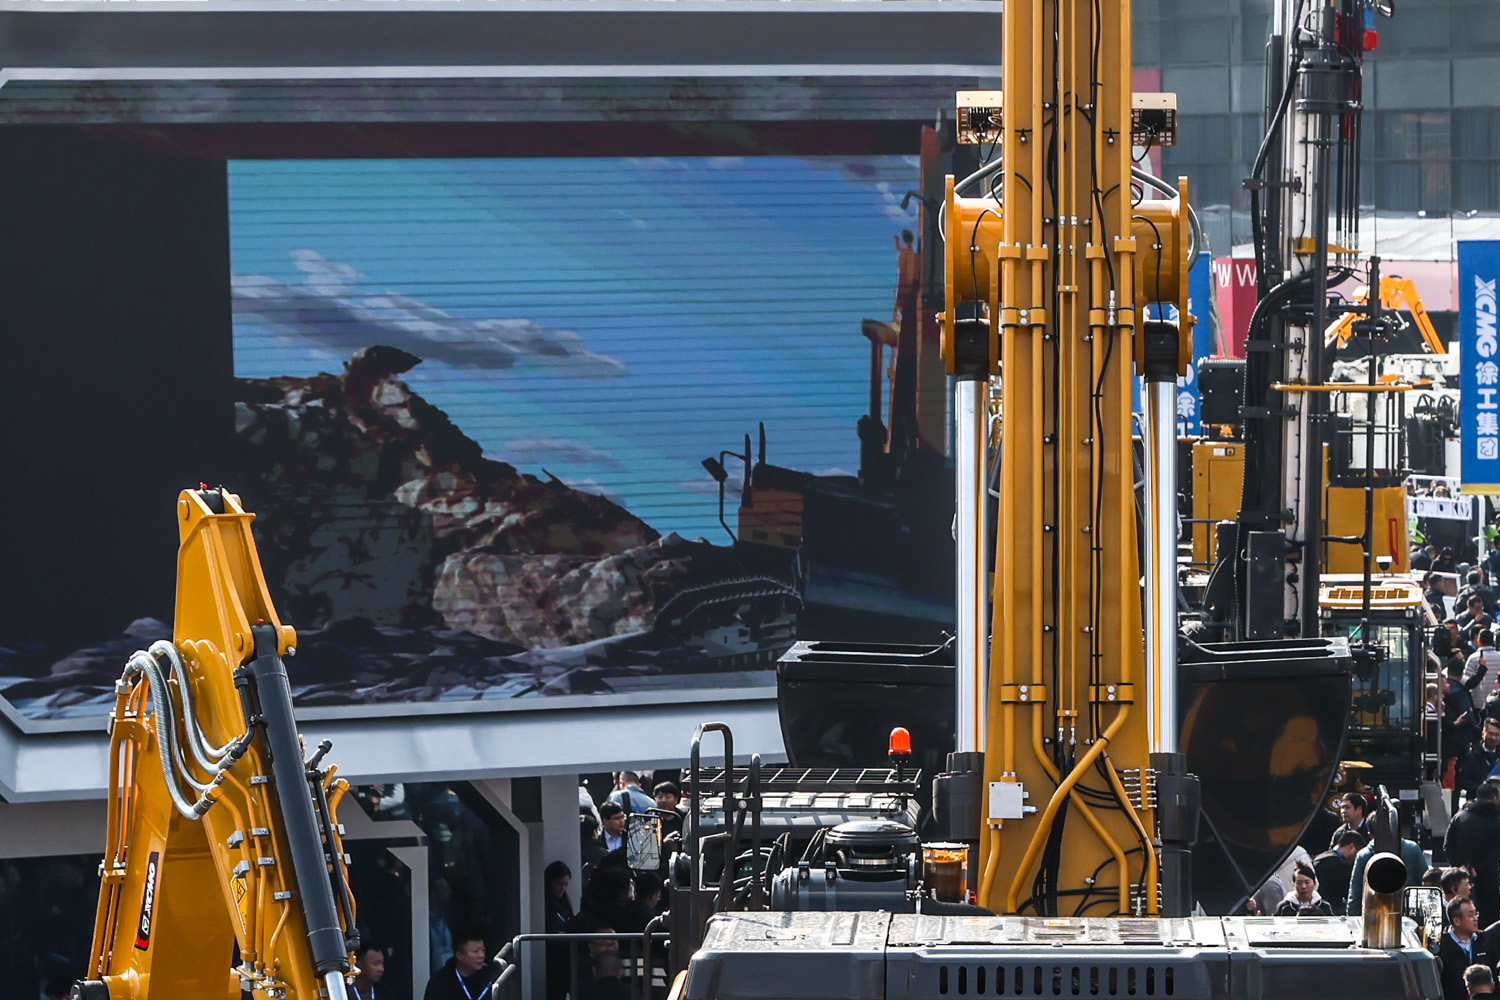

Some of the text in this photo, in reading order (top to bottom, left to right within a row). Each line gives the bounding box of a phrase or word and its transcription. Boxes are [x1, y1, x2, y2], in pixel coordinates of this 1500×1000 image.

[1475, 274, 1498, 358] XCMG
[1475, 360, 1499, 460] 徐工集团
[144, 862, 156, 920] XCMG
